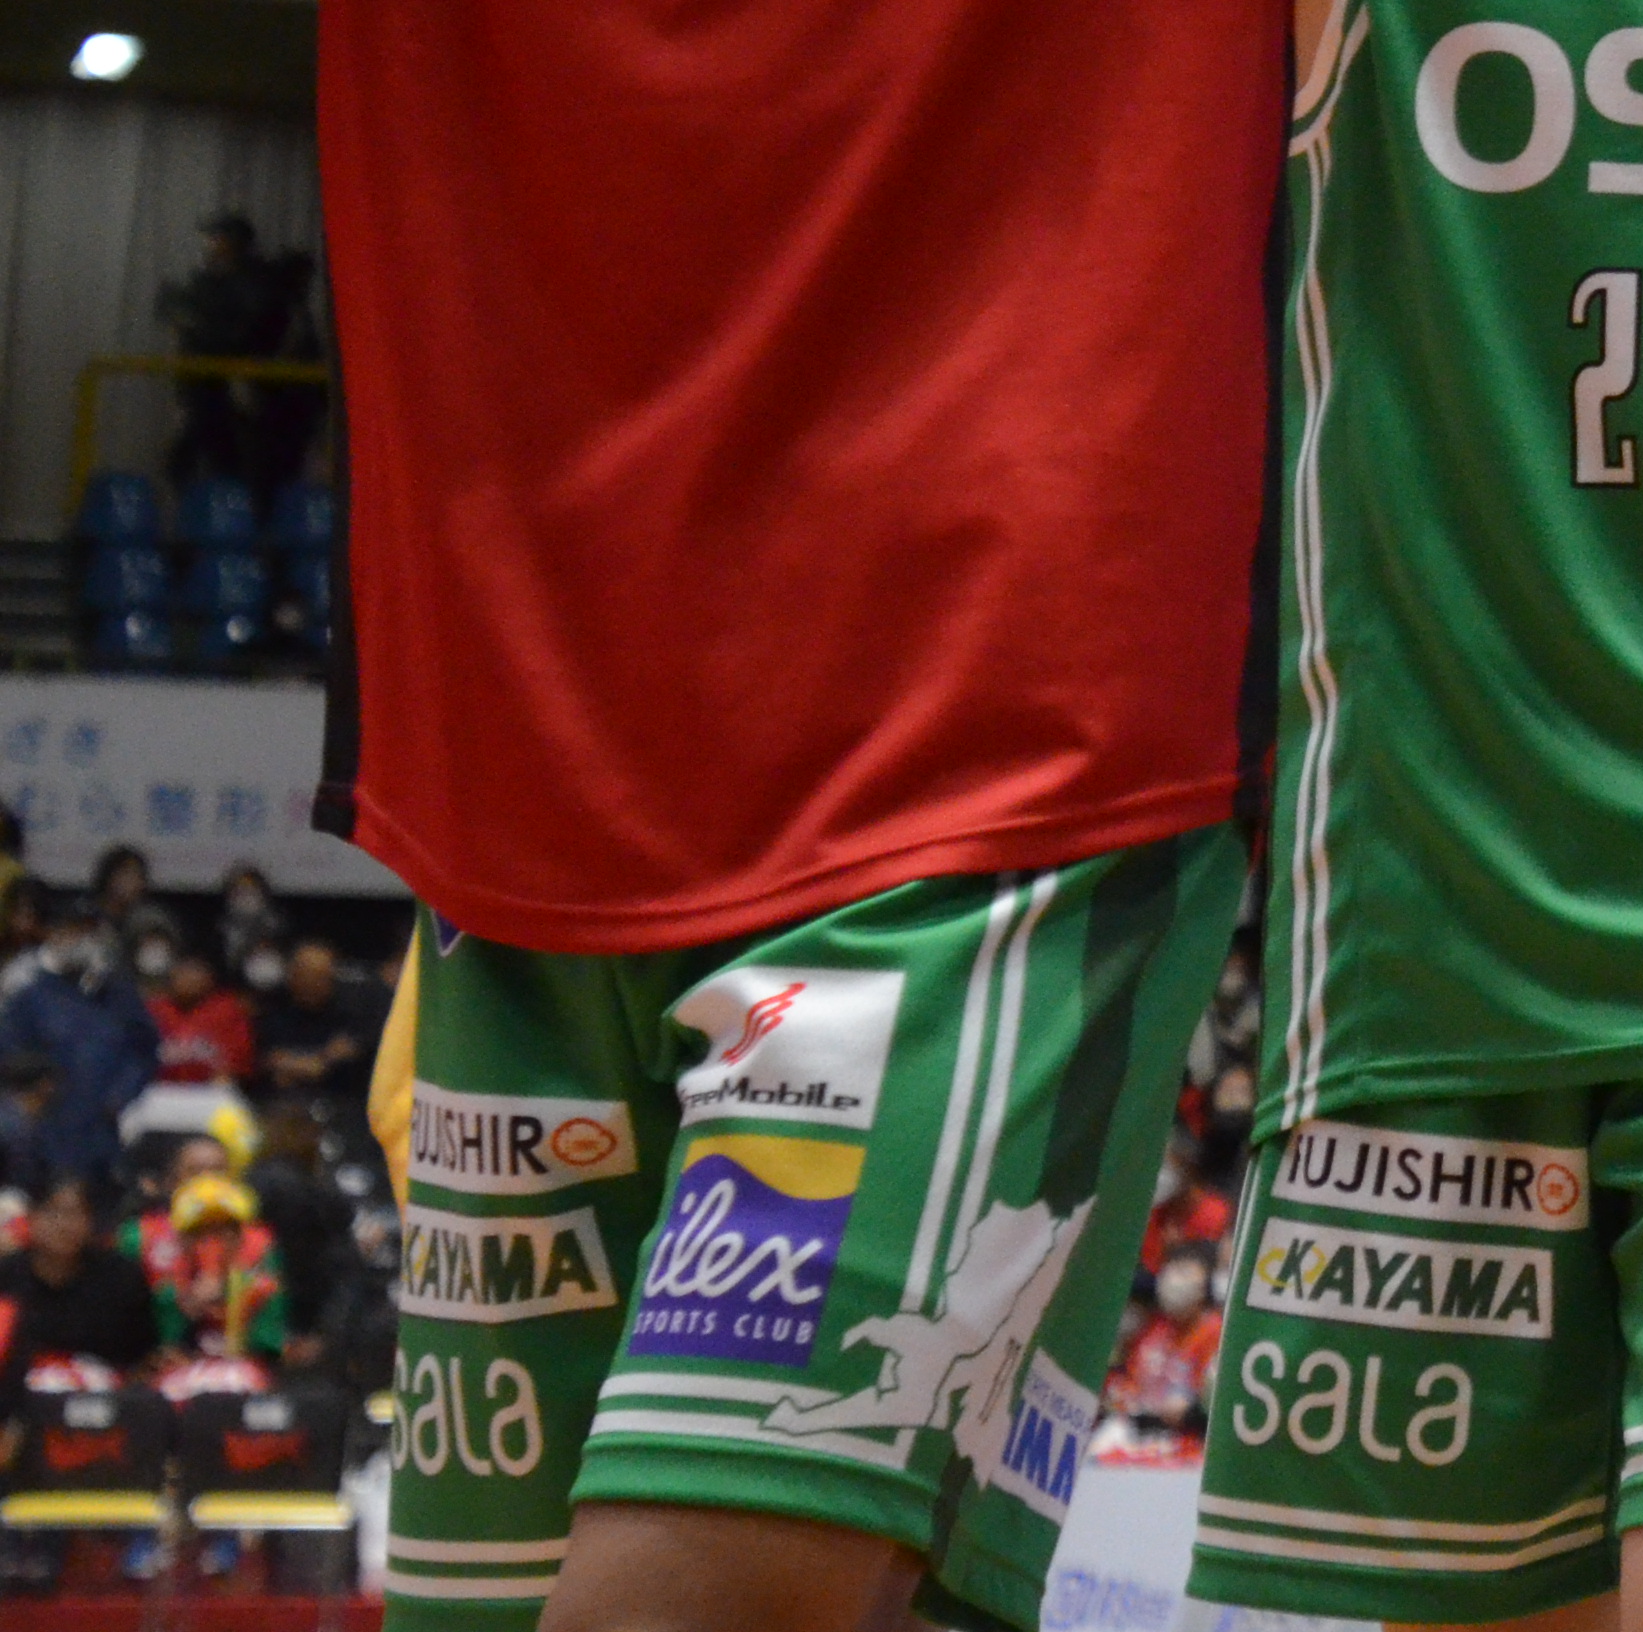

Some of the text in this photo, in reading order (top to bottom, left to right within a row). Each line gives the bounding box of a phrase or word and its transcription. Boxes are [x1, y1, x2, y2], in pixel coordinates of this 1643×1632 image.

[644, 1177, 826, 1305] ilex
[1270, 1237, 1541, 1323] KAYAMA
[633, 1309, 815, 1345] SPORTS CLUB
[1232, 1340, 1473, 1467] sala
